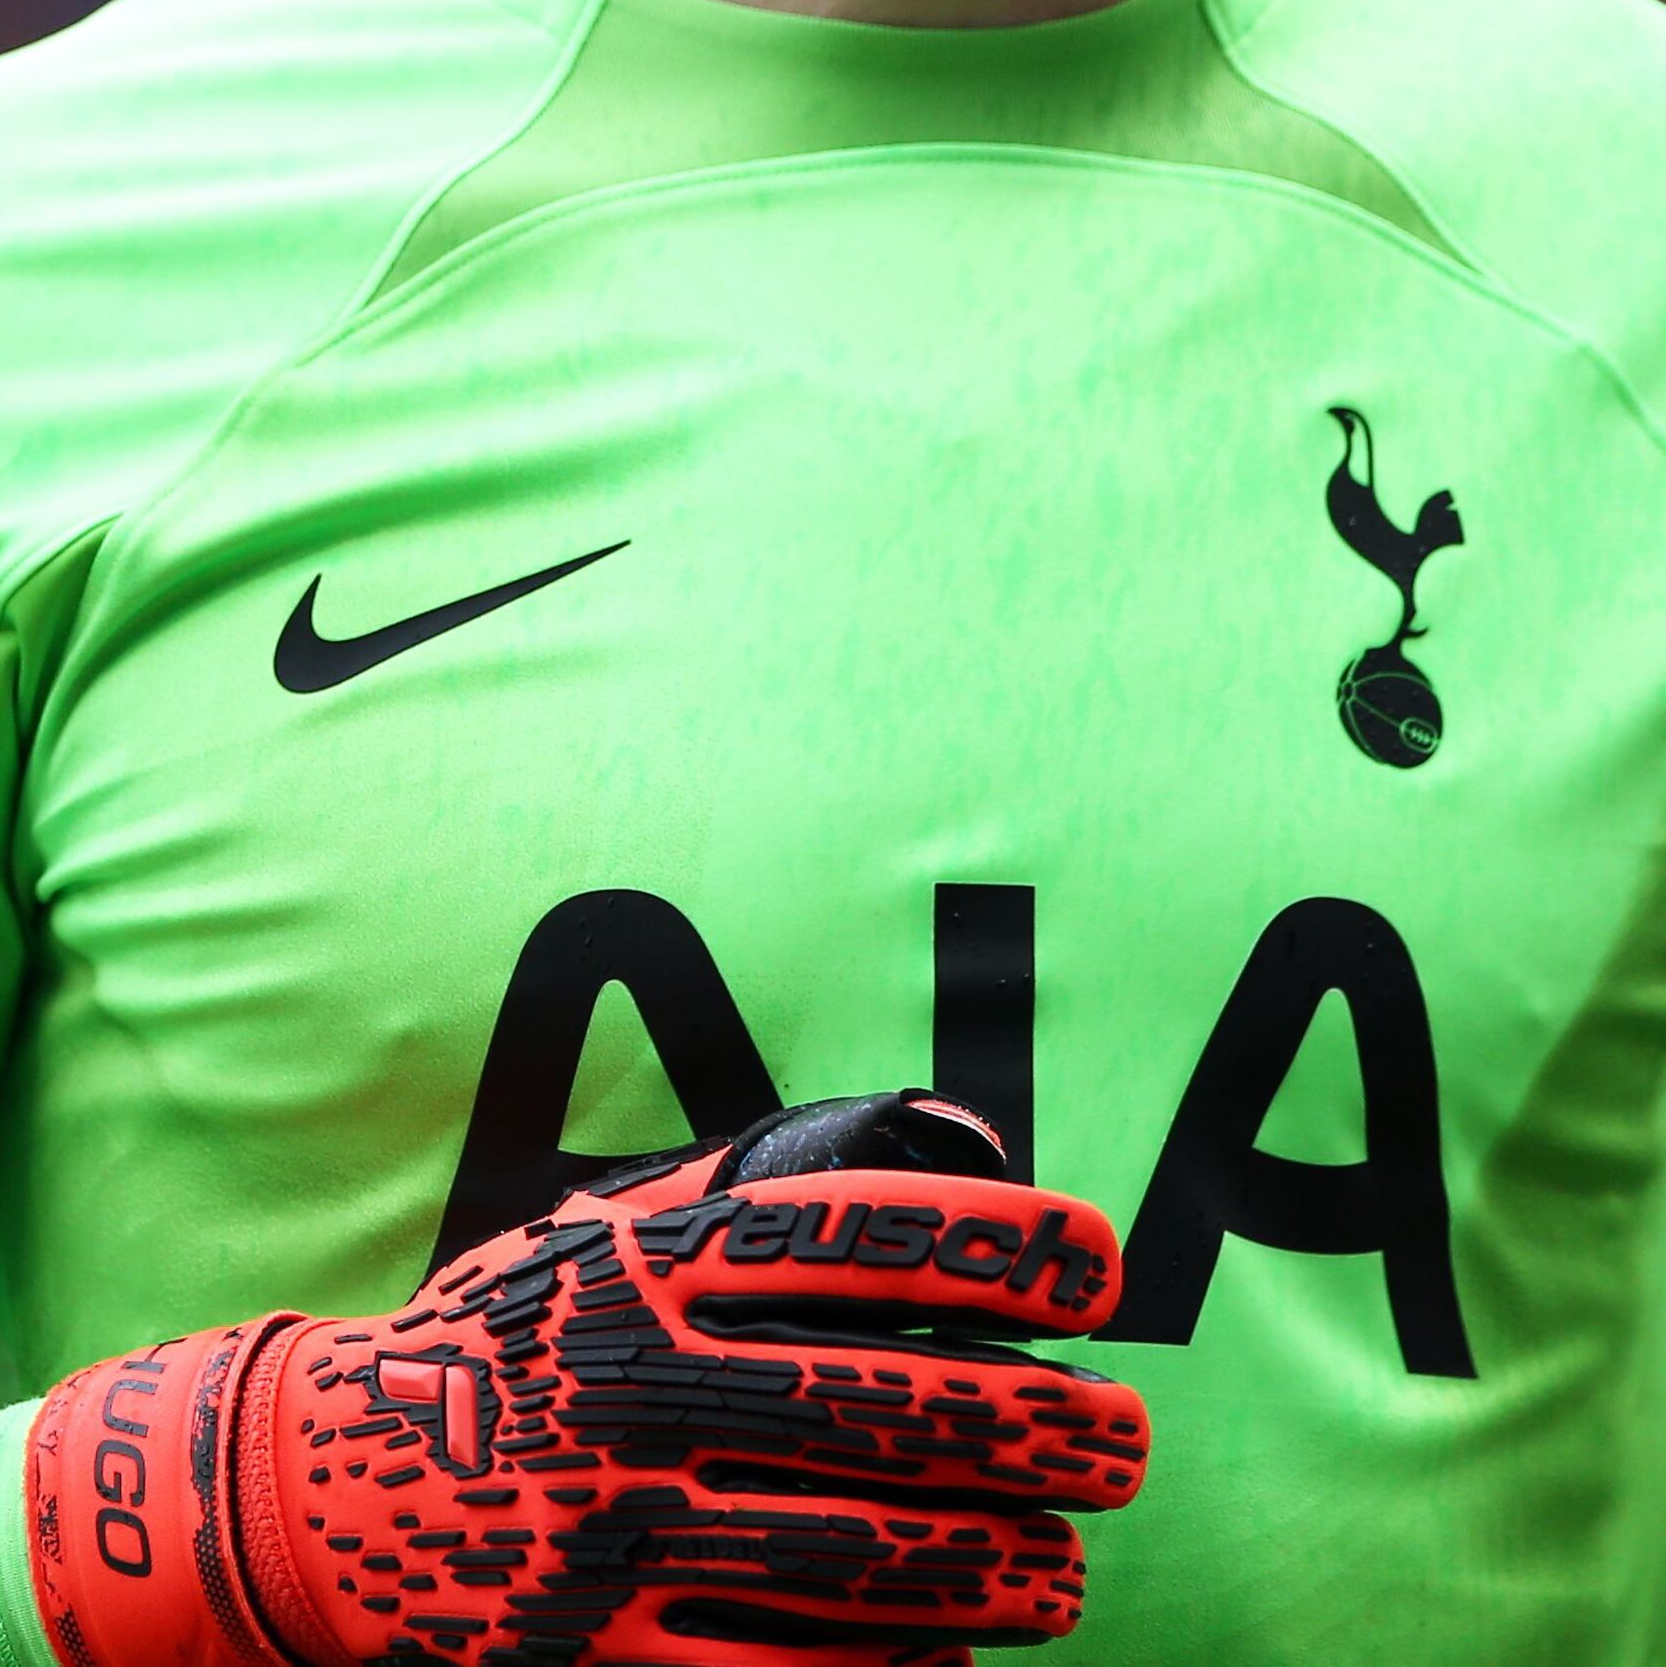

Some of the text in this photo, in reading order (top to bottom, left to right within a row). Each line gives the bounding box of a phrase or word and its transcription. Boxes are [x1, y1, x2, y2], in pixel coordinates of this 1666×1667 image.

[415, 881, 1479, 1380] AIA
[634, 1194, 1108, 1311] reusch
[93, 1336, 189, 1578] HUGO
